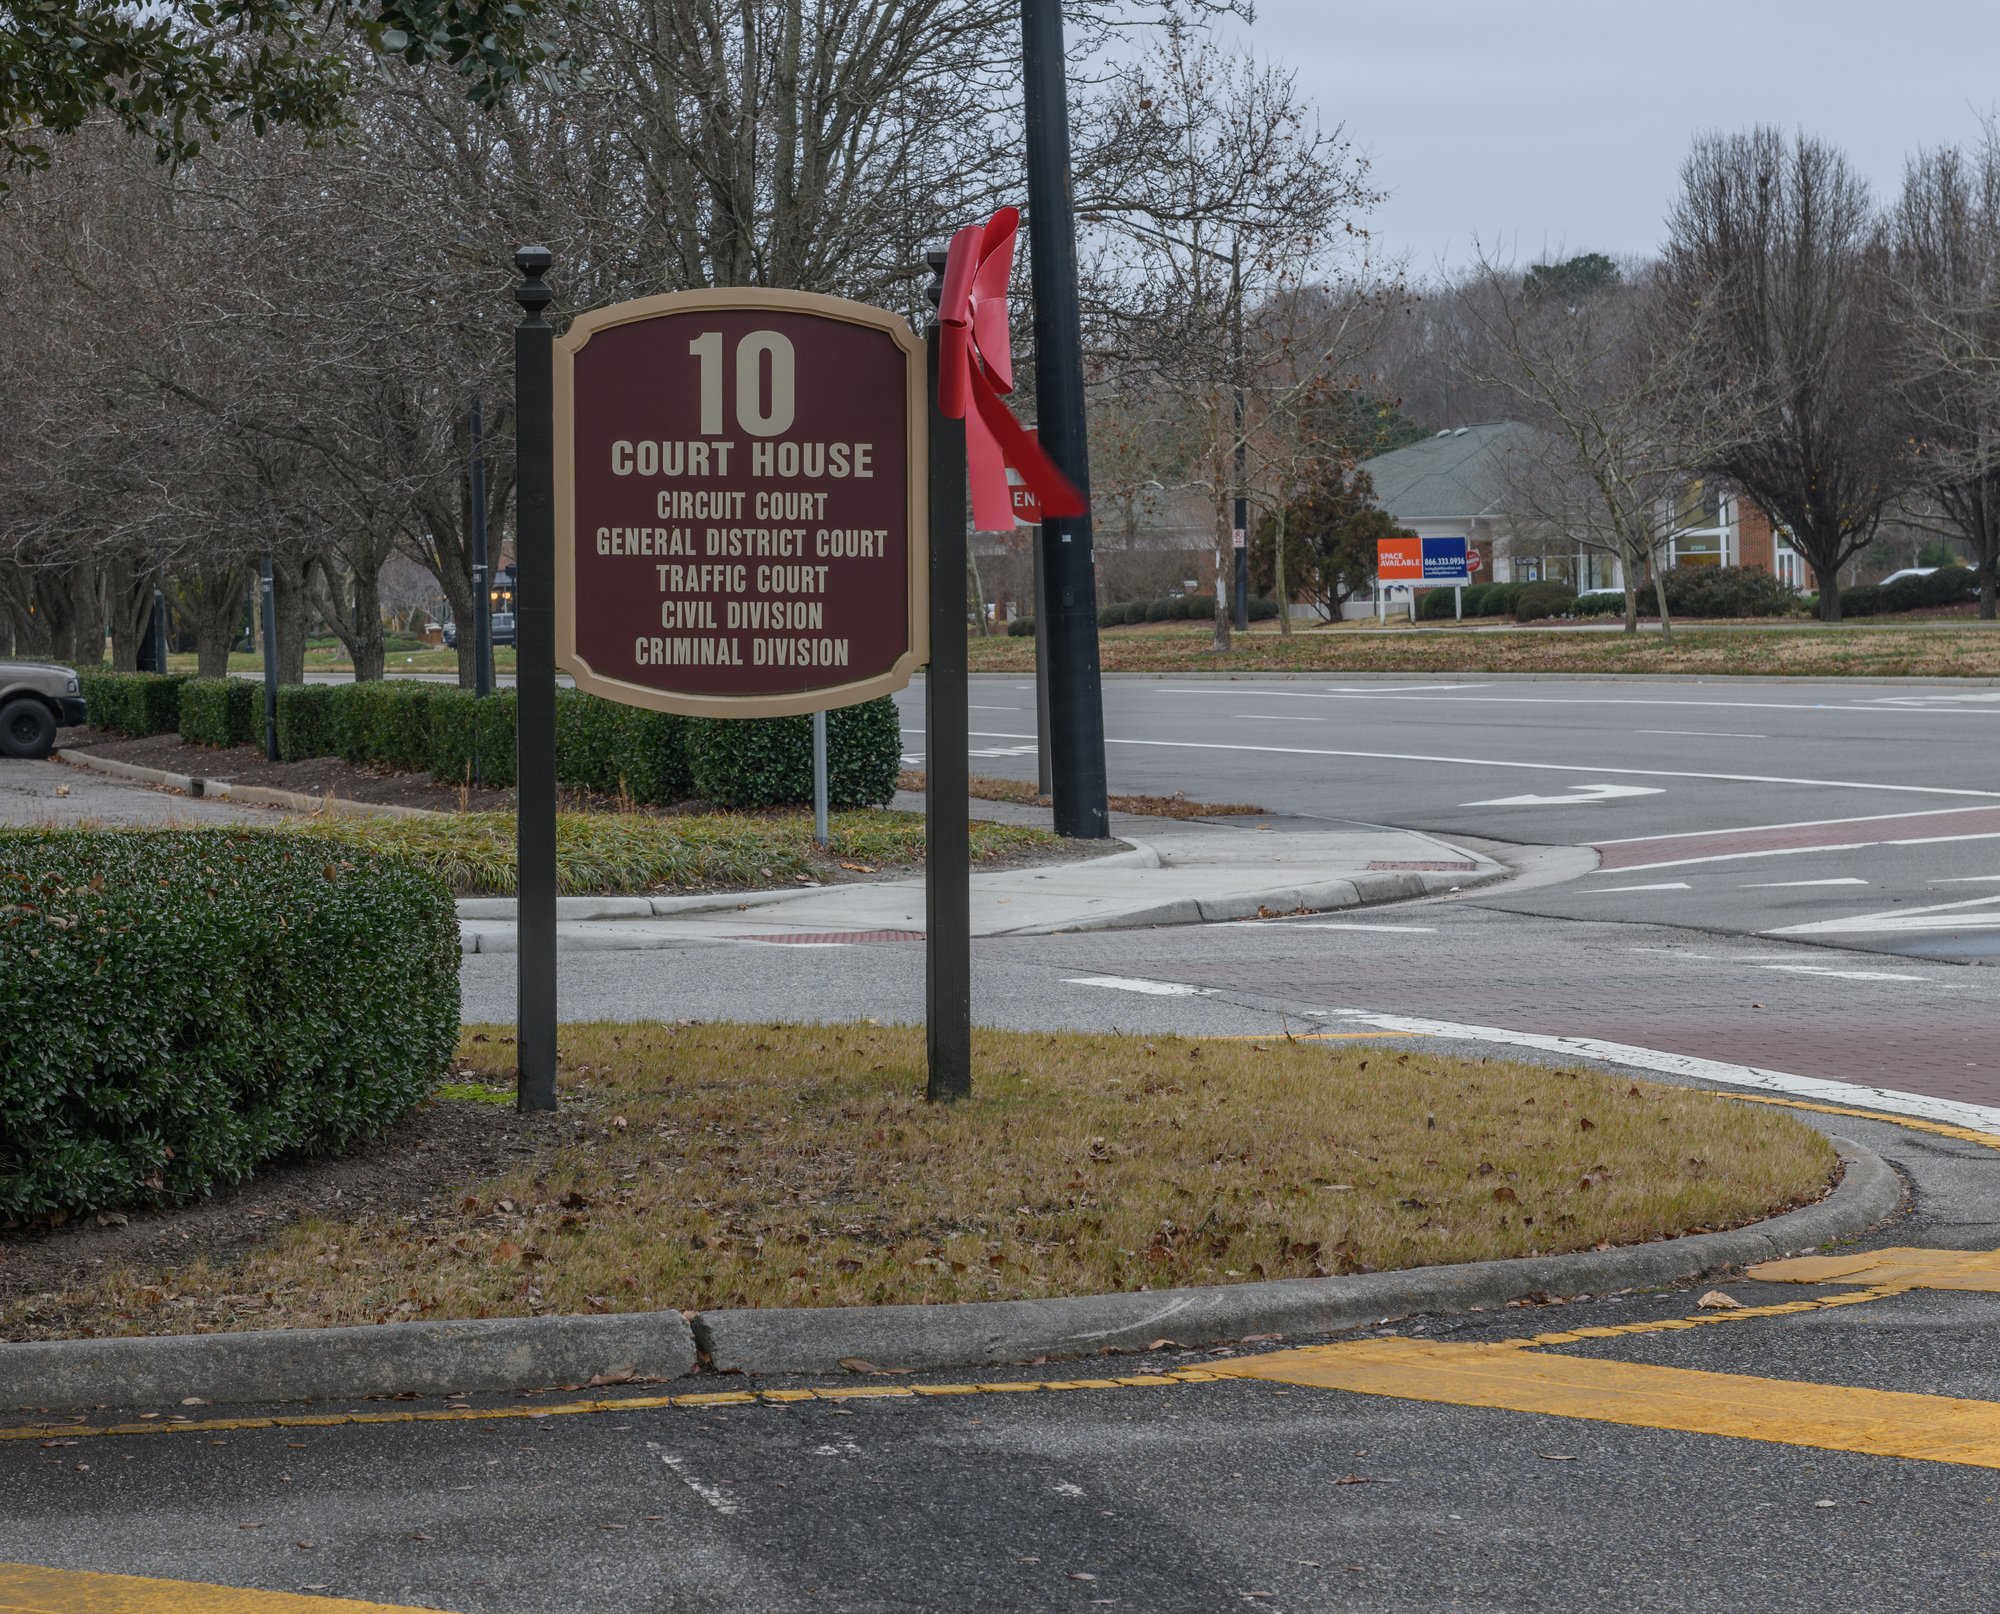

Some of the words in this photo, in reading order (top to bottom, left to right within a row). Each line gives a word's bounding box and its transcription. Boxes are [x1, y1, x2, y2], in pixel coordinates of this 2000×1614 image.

[689, 330, 795, 437] 10
[611, 440, 735, 476] COURT
[752, 441, 874, 478] HOUSE
[657, 490, 746, 520] CIRCUIT
[755, 491, 828, 521] COURT
[1014, 492, 1041, 507] EN
[596, 527, 697, 557] GENERAL
[706, 528, 807, 558] DISTRICT
[816, 529, 888, 559] COURT
[1380, 559, 1420, 567] AVAILABLE
[1424, 557, 1465, 566] 866.333.0936
[655, 564, 747, 593] TRAFFIC
[757, 564, 829, 594] COURT
[661, 600, 718, 629] CIVIL
[727, 601, 823, 630] DIVISION
[635, 636, 744, 666] CRIMINAL
[753, 637, 849, 667] DIVISION
